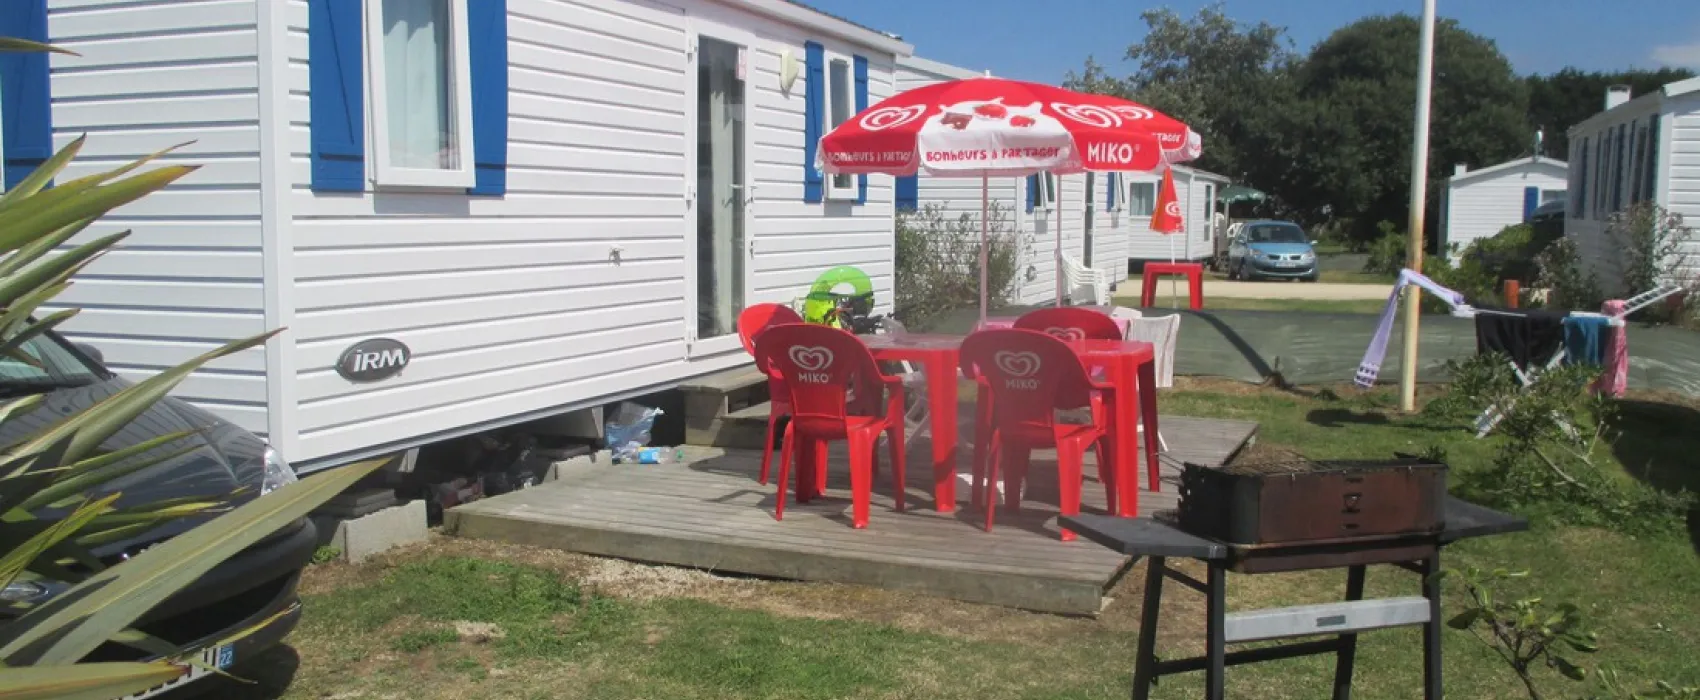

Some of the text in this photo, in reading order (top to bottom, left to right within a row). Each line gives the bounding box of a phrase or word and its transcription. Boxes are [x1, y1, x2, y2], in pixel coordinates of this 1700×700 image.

[1087, 141, 1133, 164] MIKO
[798, 372, 829, 384] MIKO
[1005, 379, 1038, 390] MIKO
